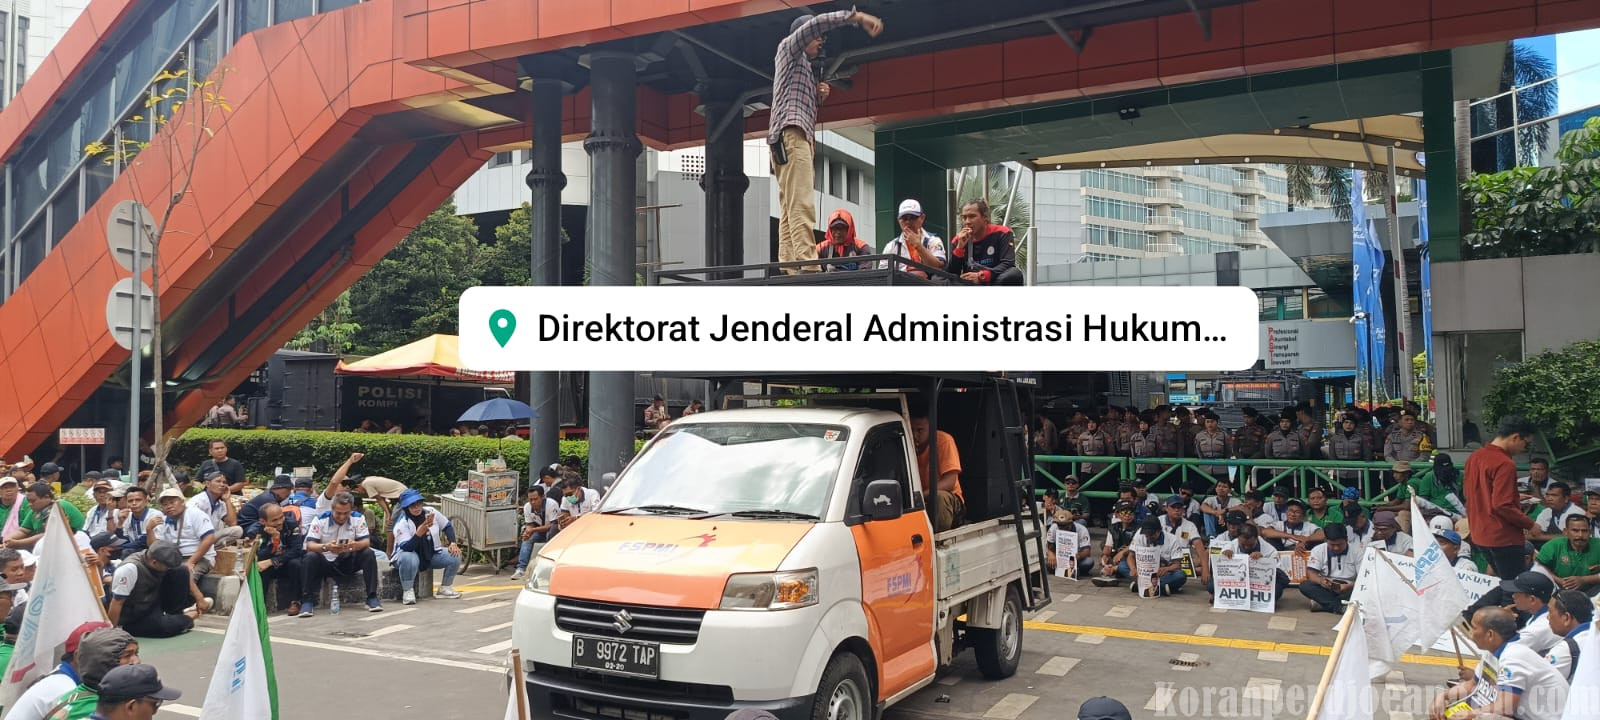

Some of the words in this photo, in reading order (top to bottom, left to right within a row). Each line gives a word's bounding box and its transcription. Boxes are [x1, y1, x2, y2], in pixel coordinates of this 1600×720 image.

[358, 385, 423, 400] POLISI
[619, 541, 680, 553] FSPMI
[887, 573, 912, 593] FSPMI
[1219, 587, 1248, 600] AHU
[1250, 590, 1272, 603] HU
[576, 639, 585, 657] B
[596, 641, 628, 663] 9972
[632, 645, 655, 666] TAP
